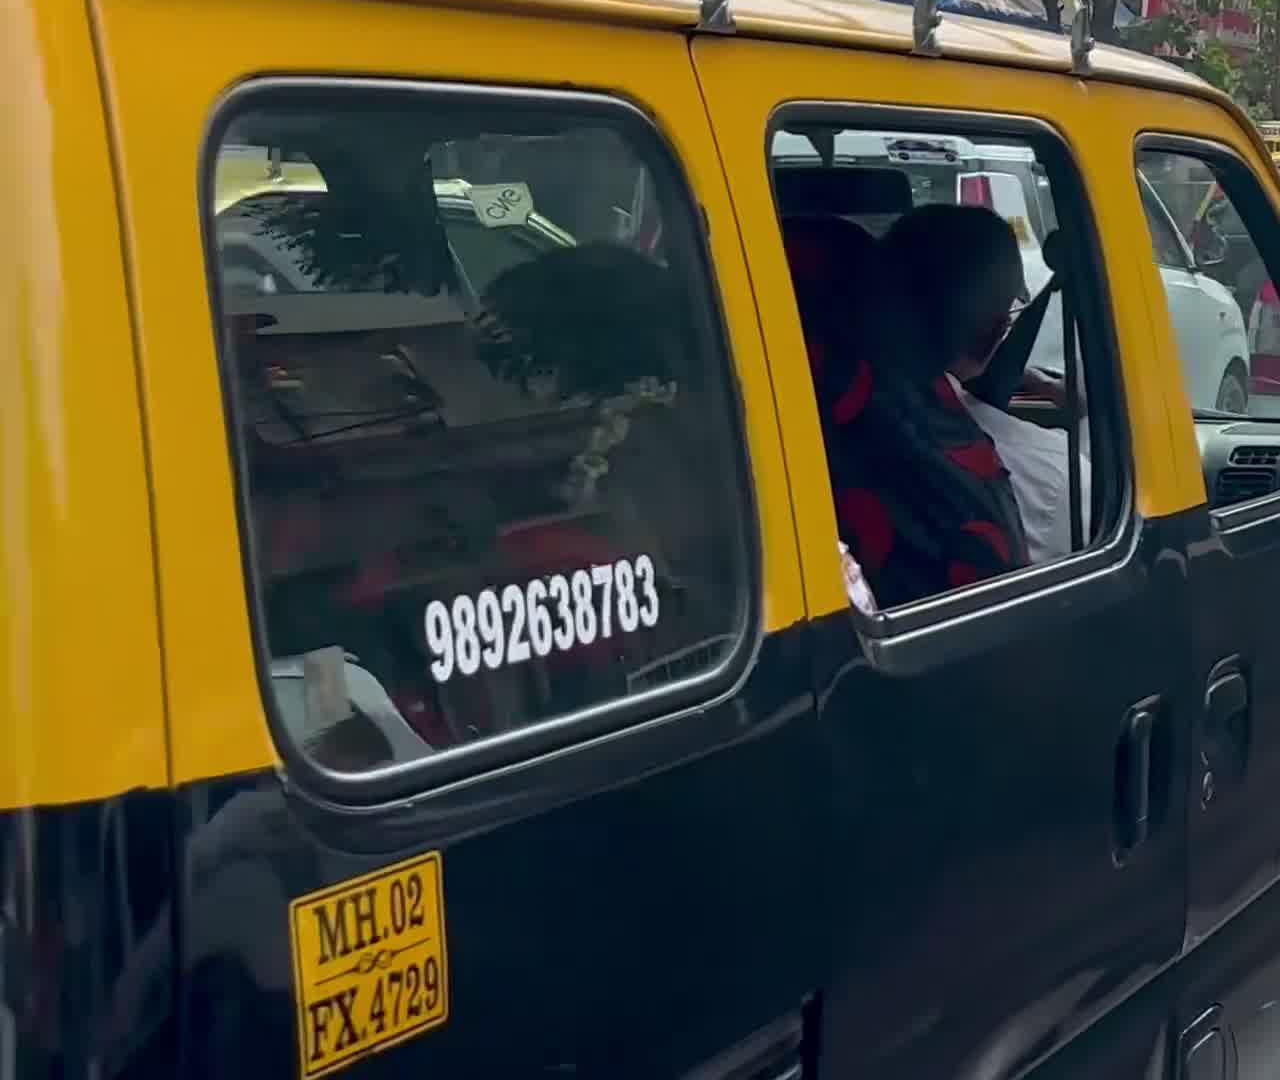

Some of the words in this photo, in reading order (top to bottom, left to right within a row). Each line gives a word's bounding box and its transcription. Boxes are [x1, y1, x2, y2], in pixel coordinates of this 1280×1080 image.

[424, 554, 659, 682] 9892638783
[313, 873, 424, 965] MH.02
[308, 956, 439, 1062] FX.4729
